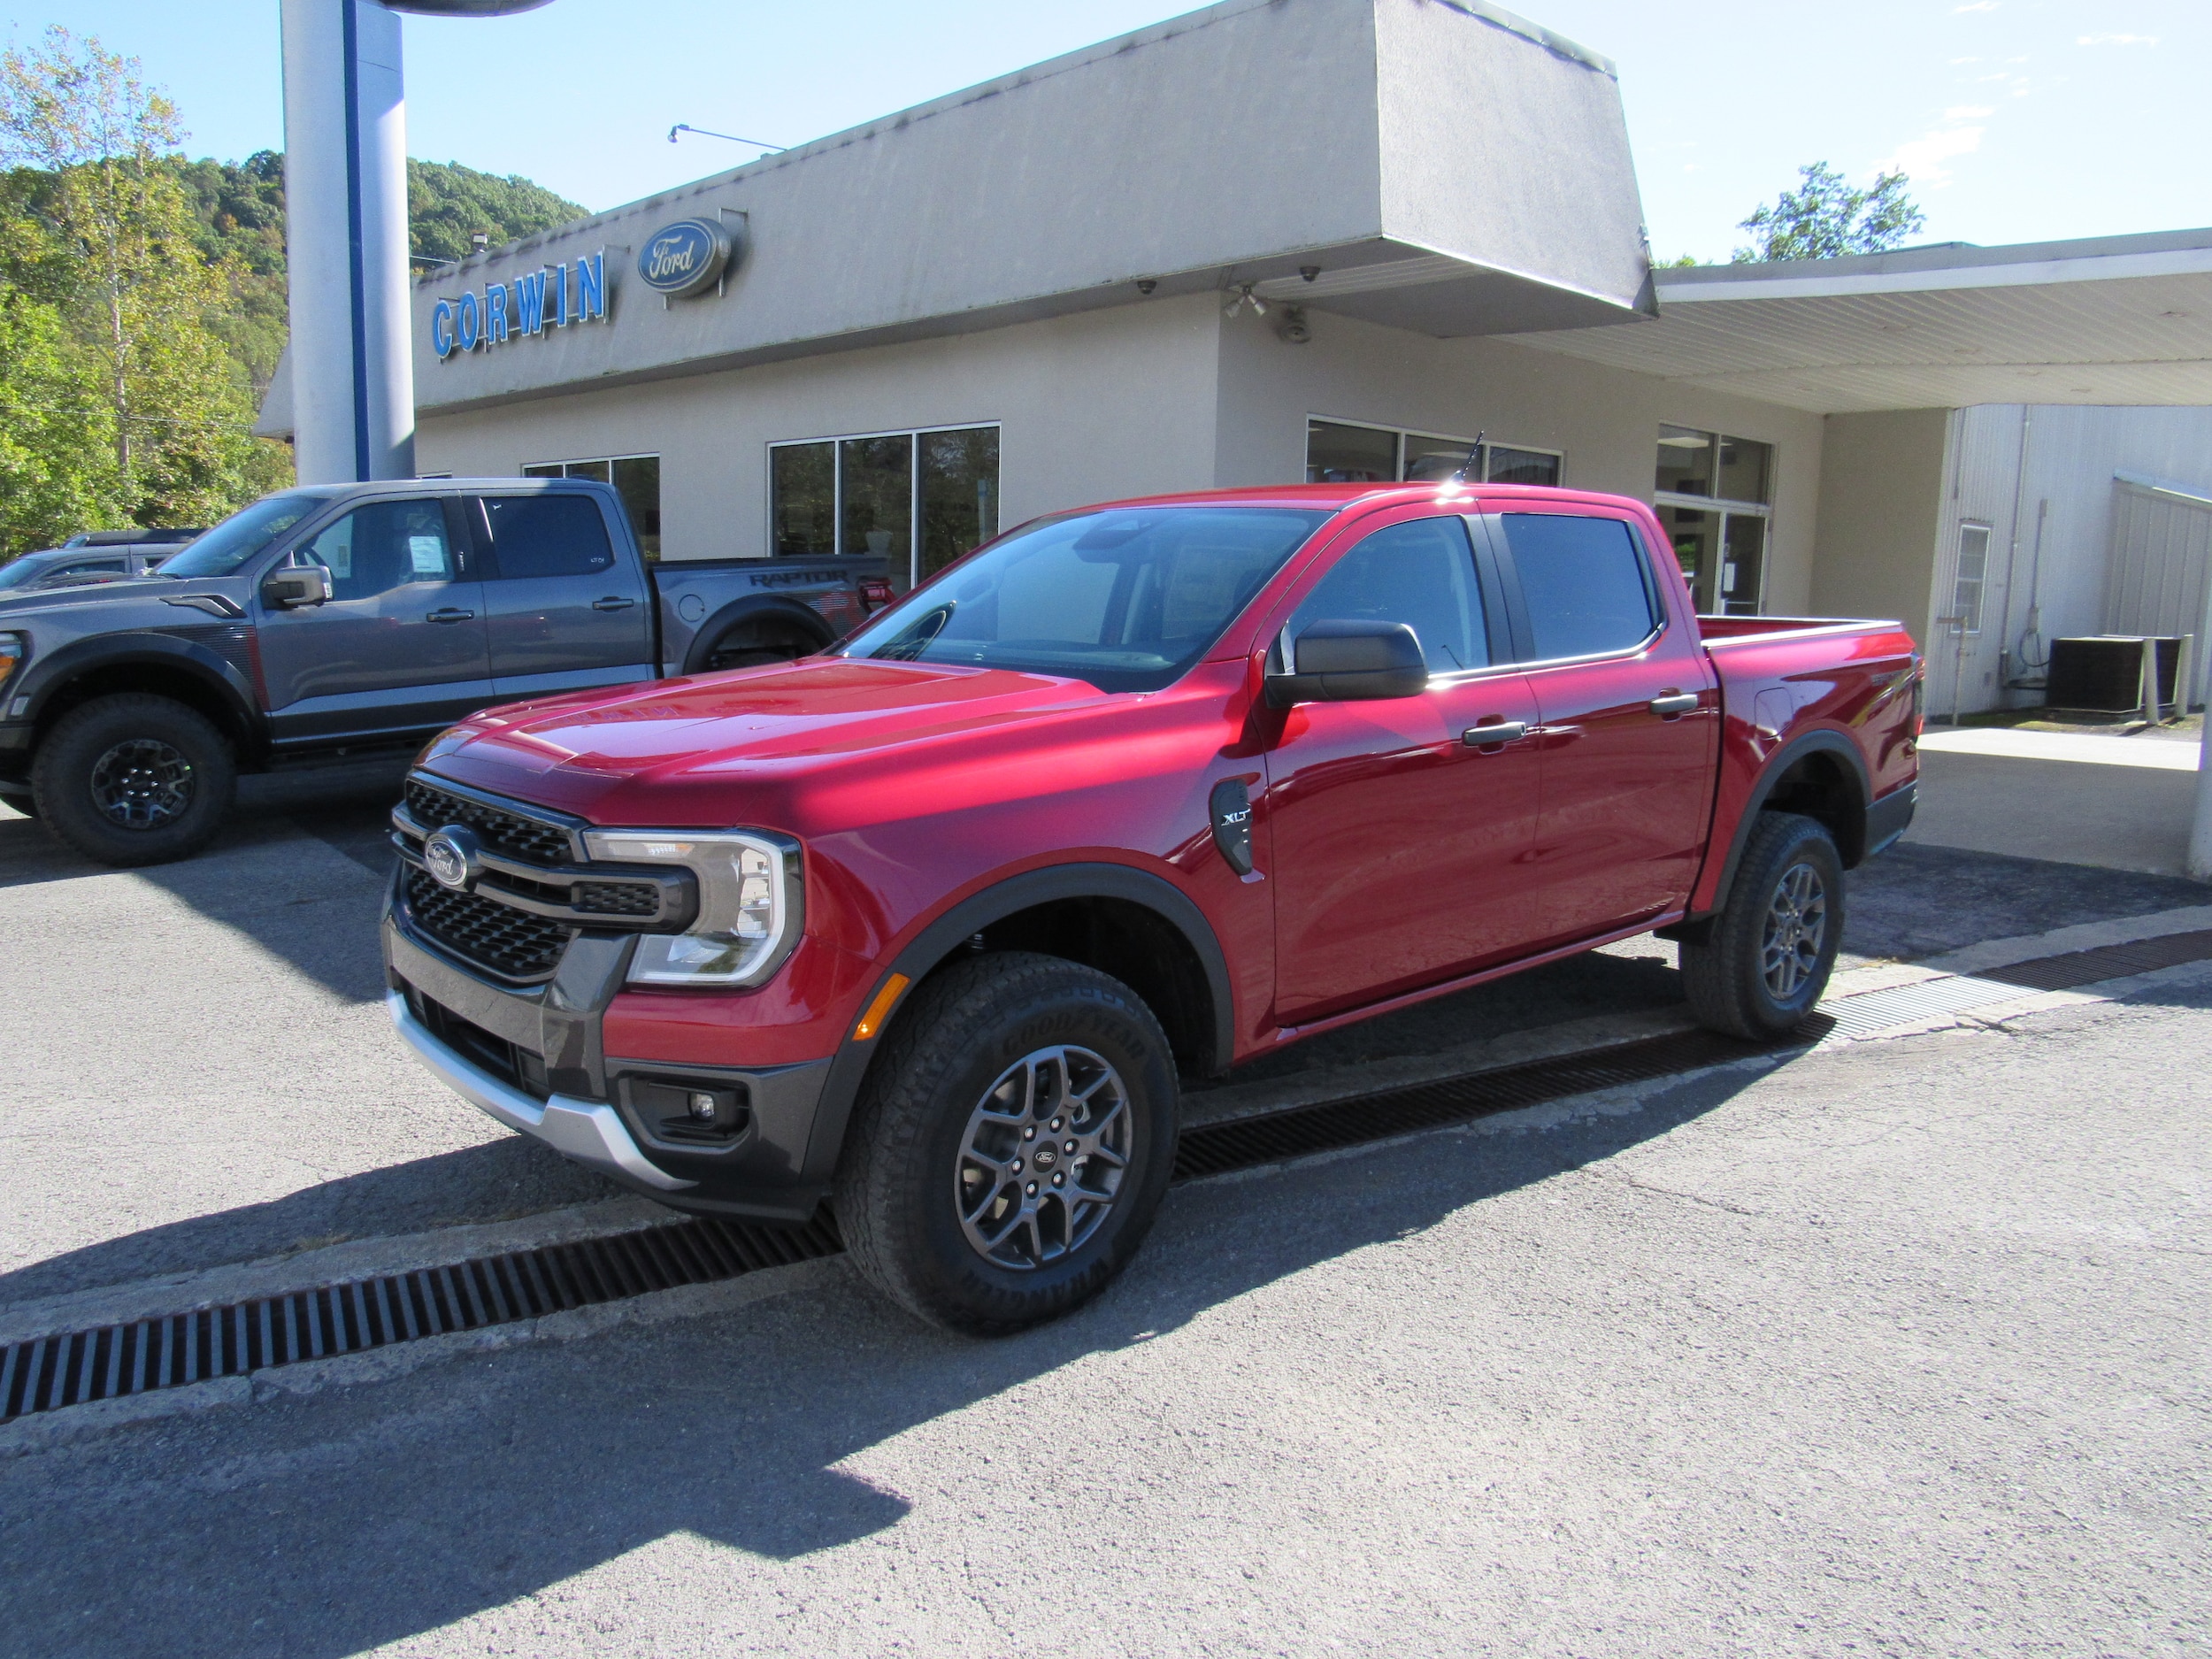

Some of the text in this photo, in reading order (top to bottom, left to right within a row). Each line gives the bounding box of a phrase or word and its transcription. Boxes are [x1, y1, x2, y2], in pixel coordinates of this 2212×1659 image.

[649, 235, 694, 280] Ford
[432, 250, 605, 358] CORWIN
[749, 570, 850, 588] RAPTOR
[1221, 808, 1251, 826] XLT
[430, 845, 455, 876] Ford
[1002, 1005, 1146, 1060] GOODYEAR
